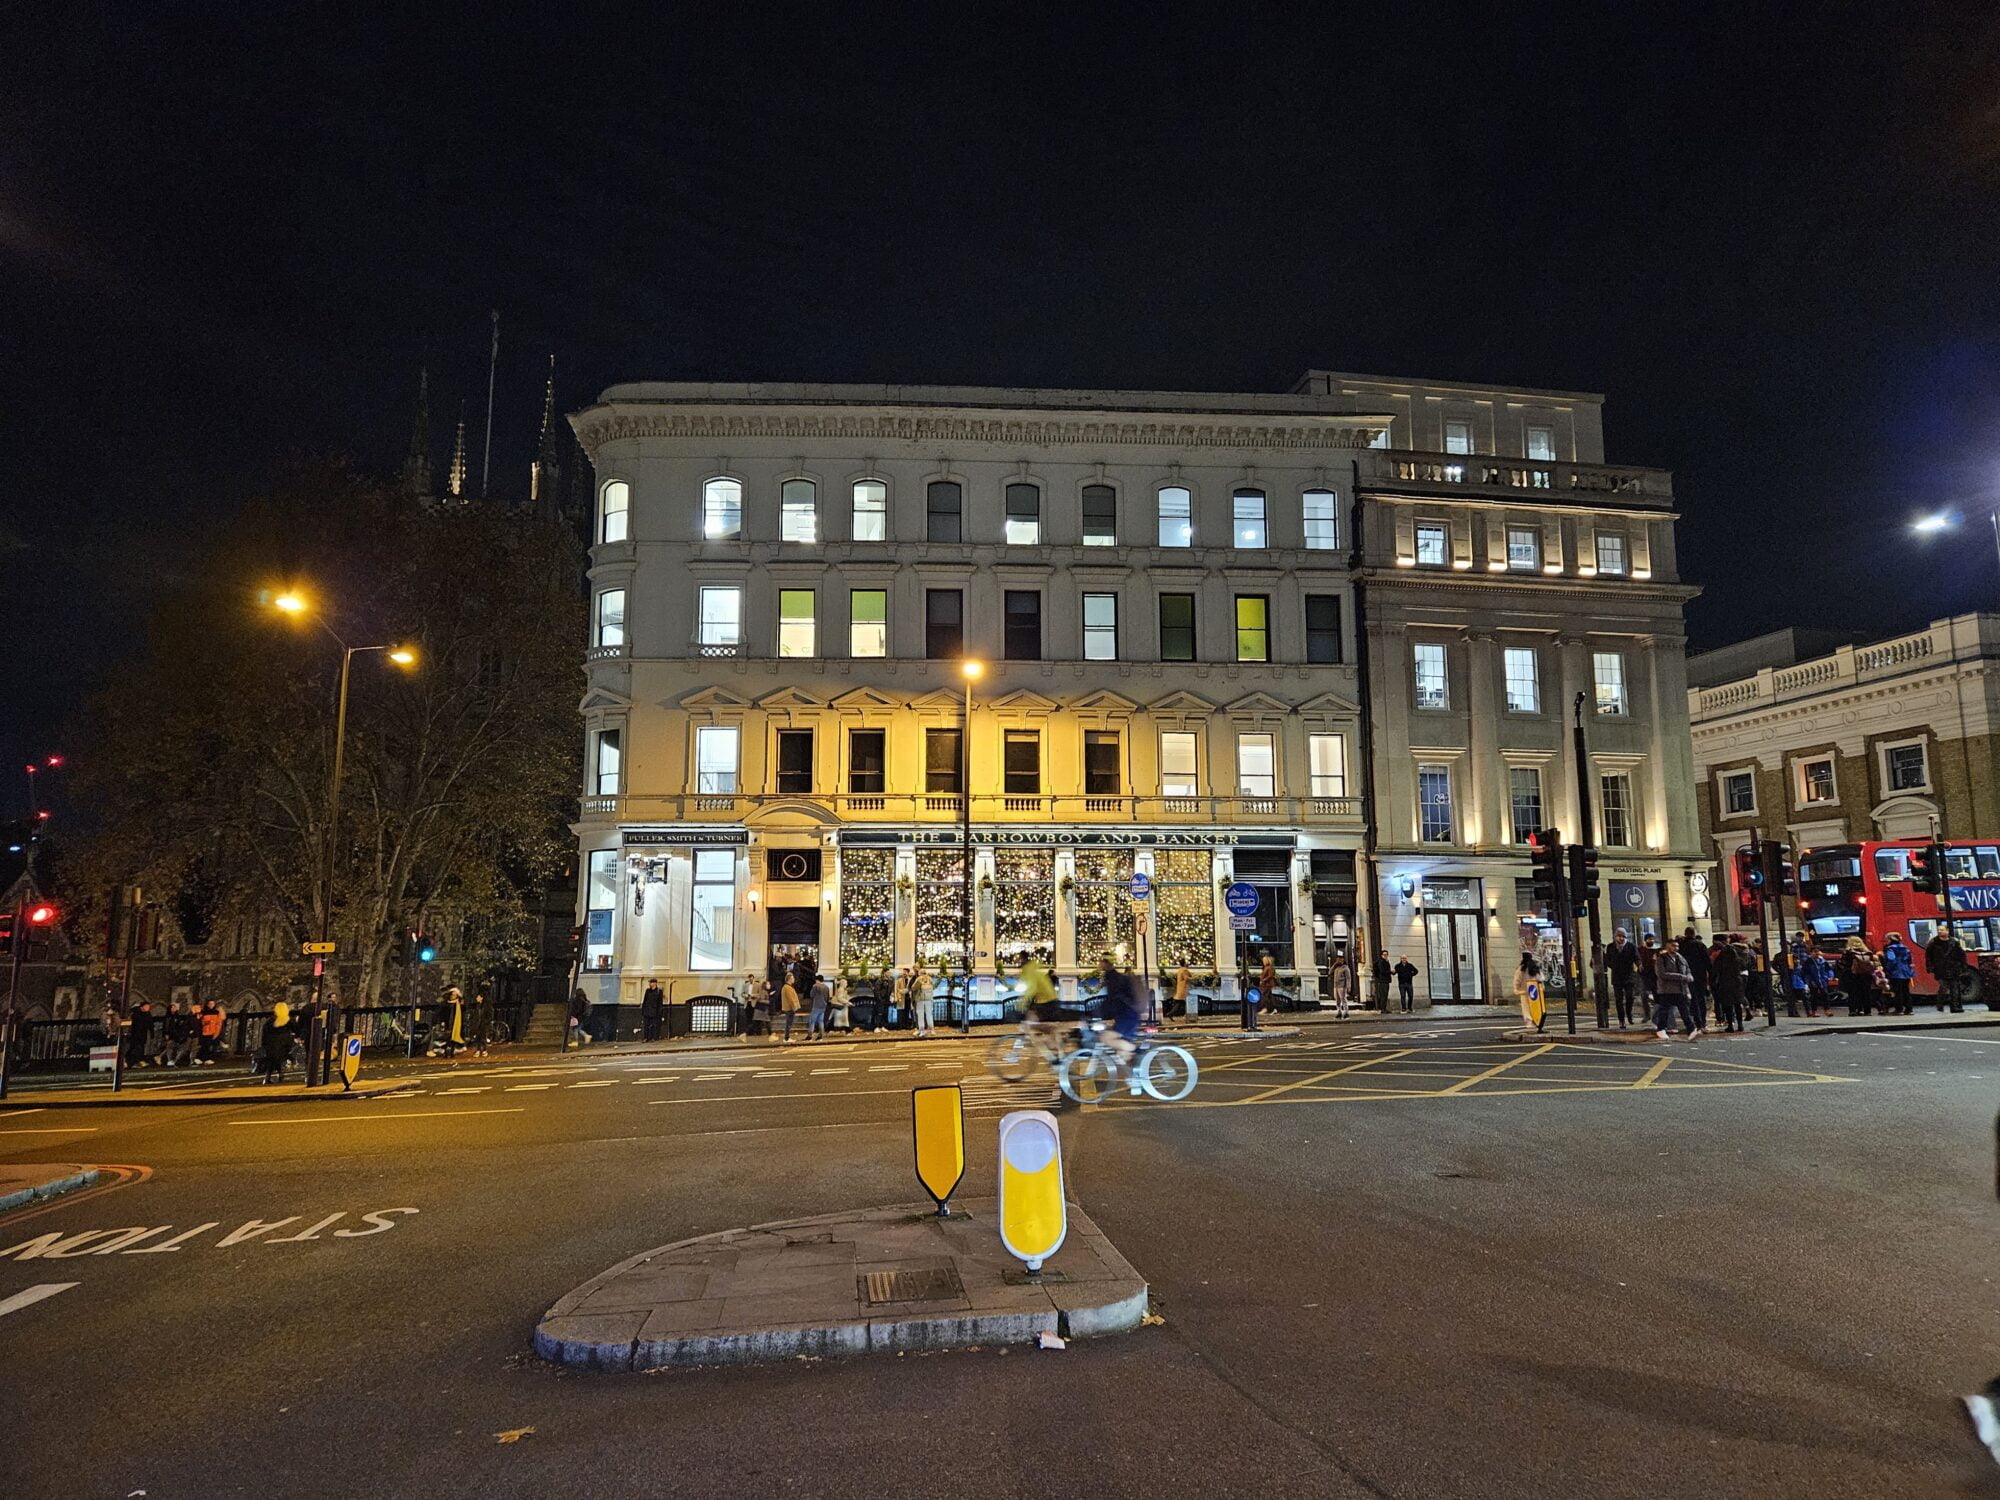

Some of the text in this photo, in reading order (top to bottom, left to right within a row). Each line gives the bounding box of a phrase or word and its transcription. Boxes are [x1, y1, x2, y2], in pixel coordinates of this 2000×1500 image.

[898, 832, 1239, 845] THE BARROWBOY AND BANKER
